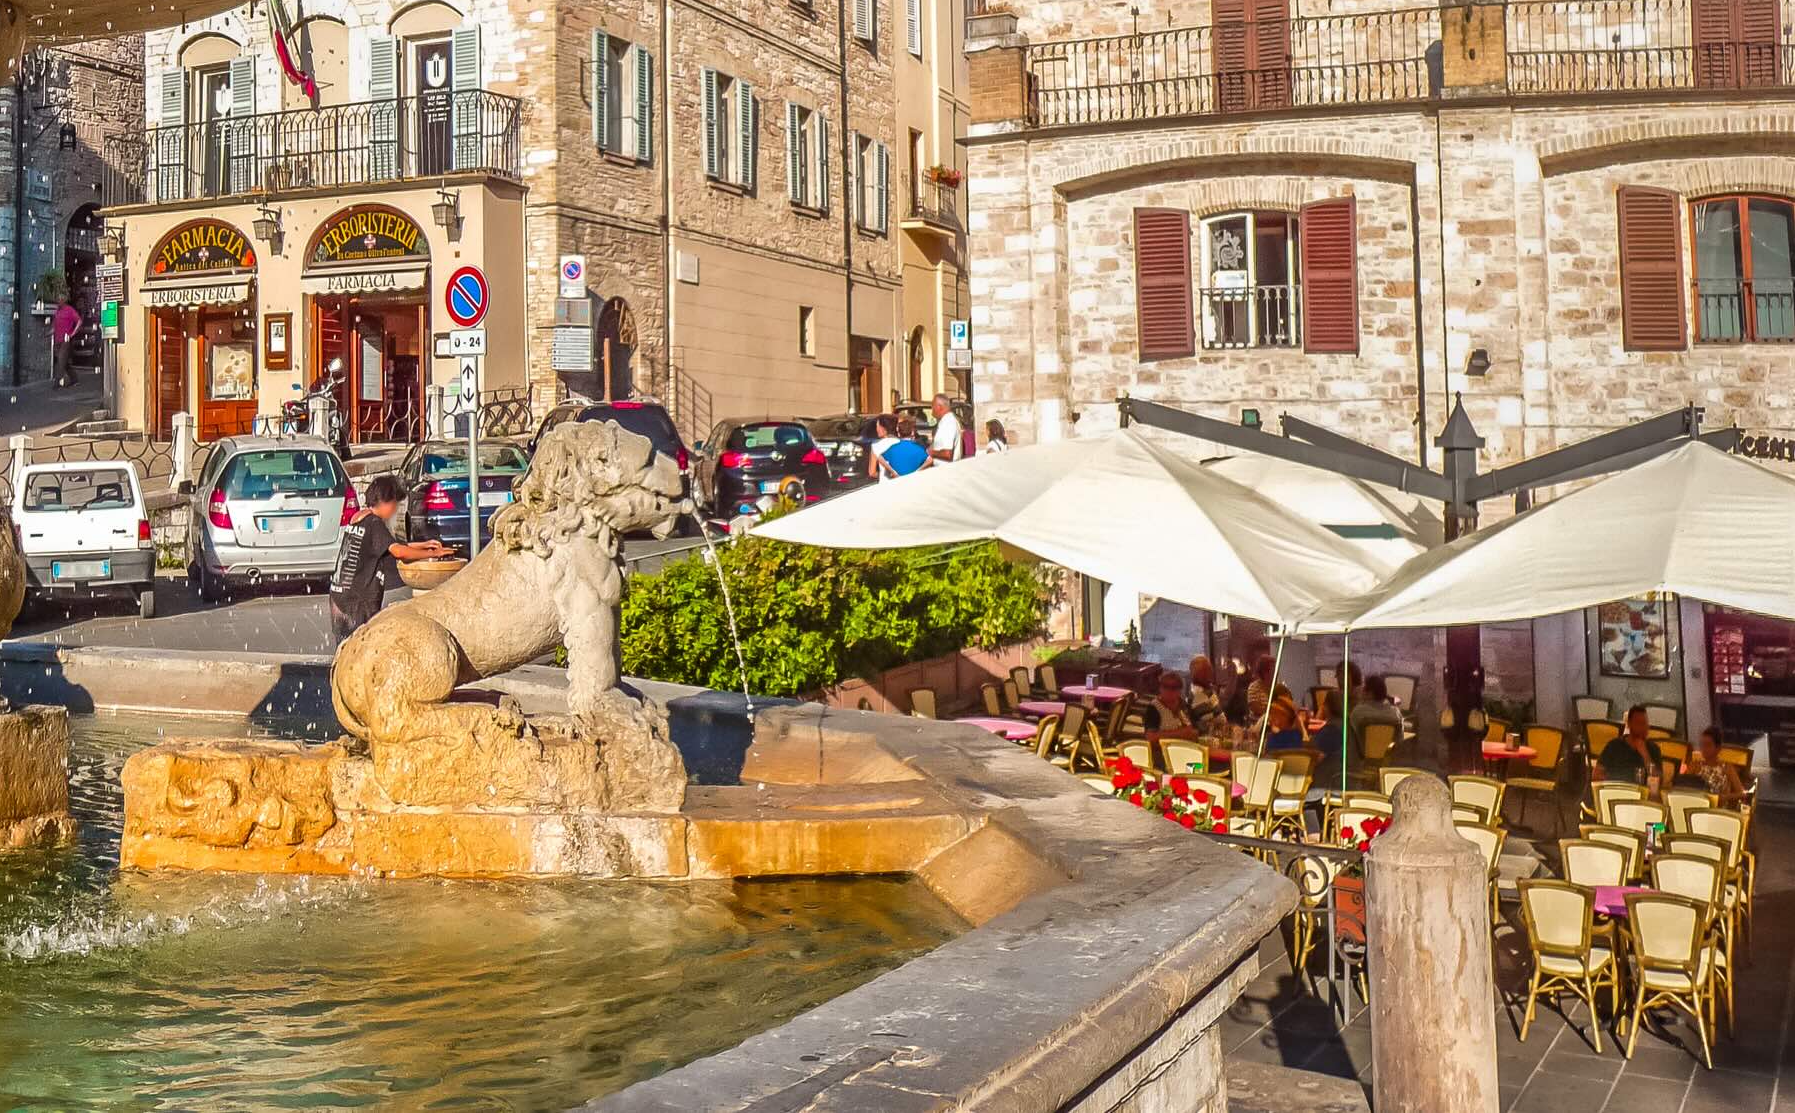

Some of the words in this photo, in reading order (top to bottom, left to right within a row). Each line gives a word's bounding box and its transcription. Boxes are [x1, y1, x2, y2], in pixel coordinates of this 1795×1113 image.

[322, 212, 418, 256] ERBORISTERIA
[162, 225, 244, 265] FARMACIA
[327, 273, 396, 290] FARMACIA
[151, 286, 236, 304] ERBORISTERIA
[469, 336, 481, 348] 24
